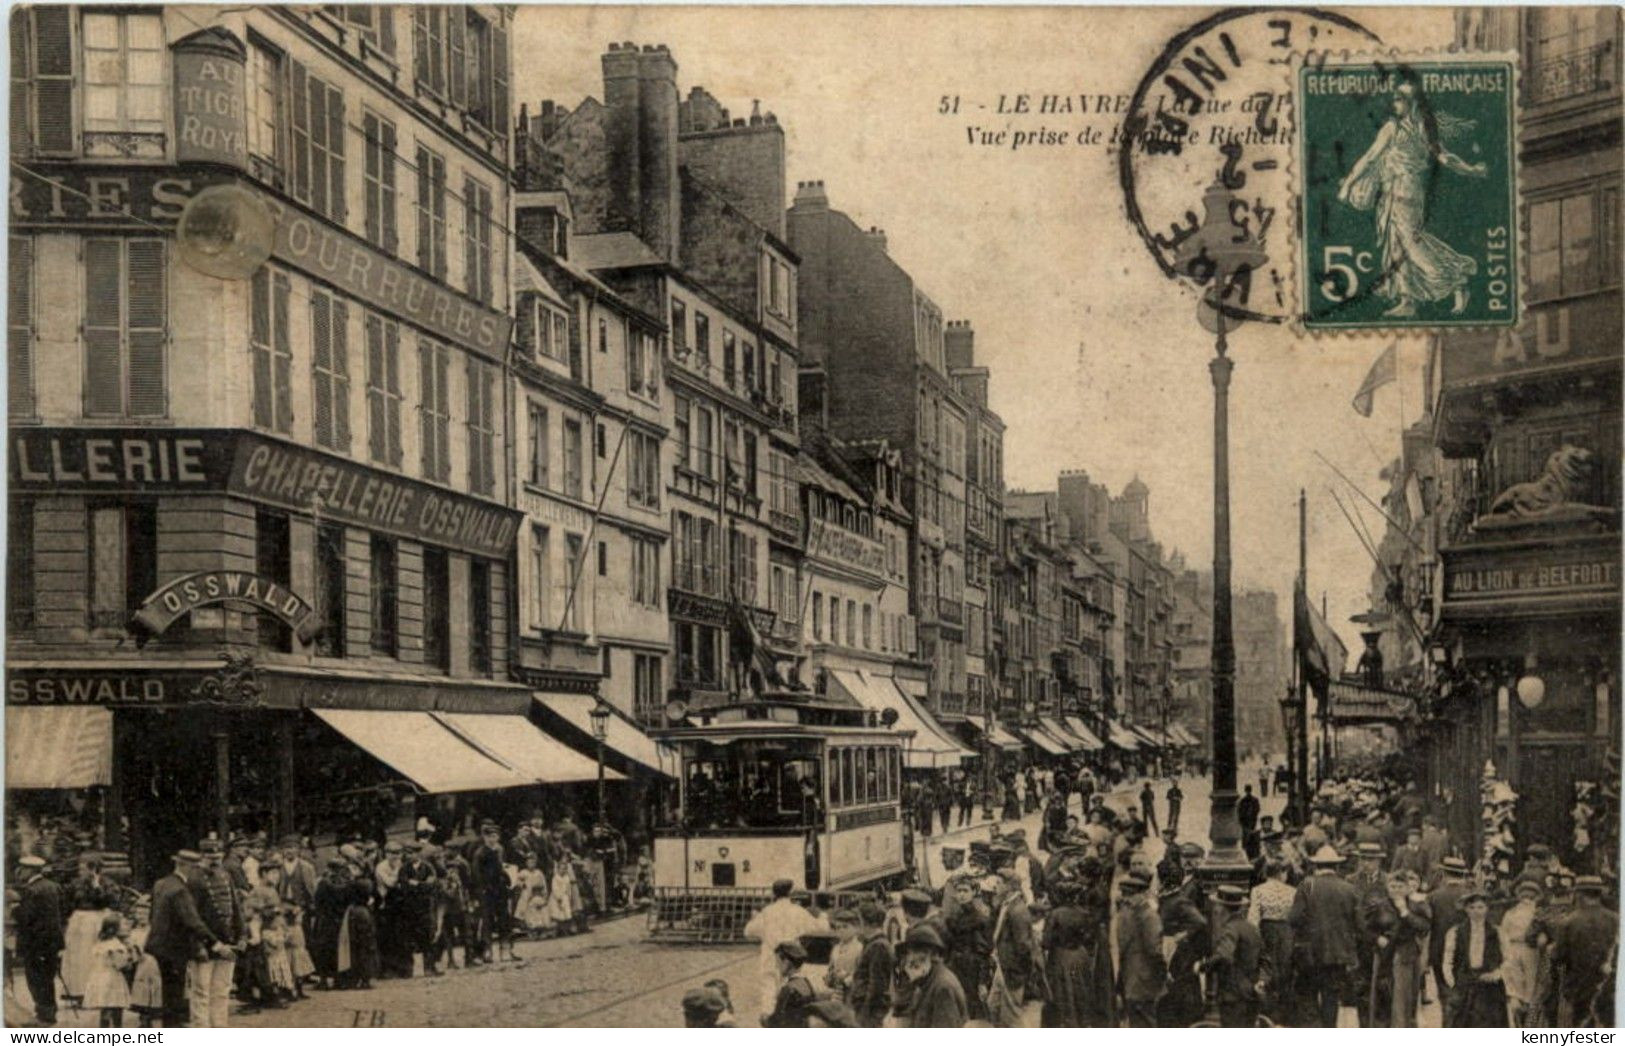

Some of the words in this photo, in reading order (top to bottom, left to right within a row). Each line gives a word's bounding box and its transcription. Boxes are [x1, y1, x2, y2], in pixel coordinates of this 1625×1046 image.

[201, 61, 239, 85] AU
[1422, 72, 1504, 94] FRANÇAISE
[1487, 226, 1507, 311] POSTES
[1493, 307, 1570, 366] AU
[243, 445, 414, 525] CHAPELLERIE
[419, 493, 513, 549] OSSWALD
[163, 573, 300, 616] OSSWALD
[1454, 572, 1473, 592] AU
[1477, 569, 1514, 590] LION
[8, 678, 165, 702] SSWALD
